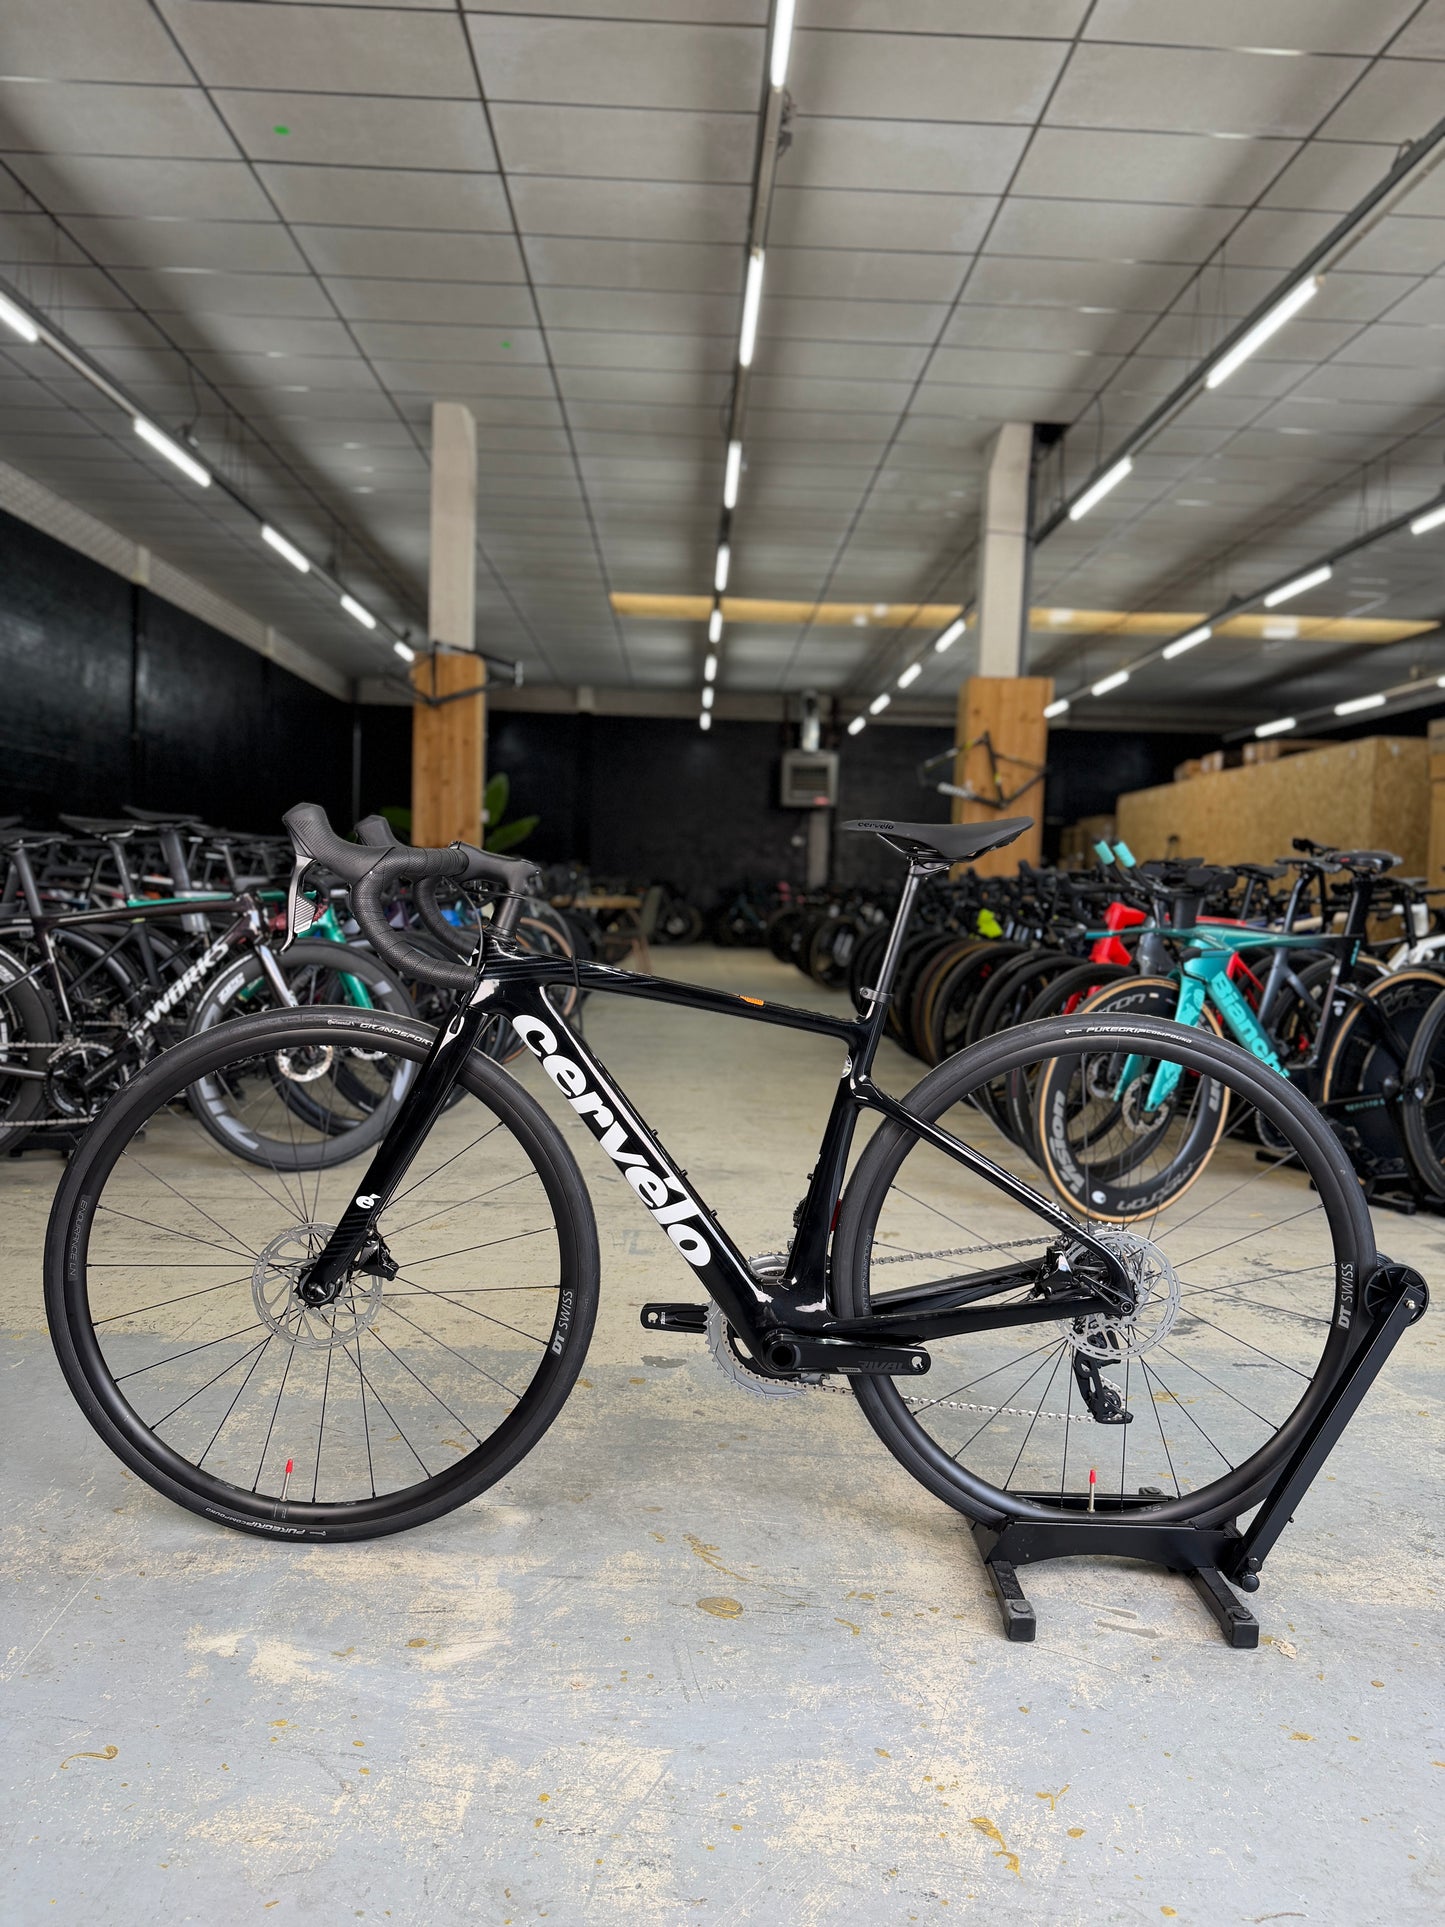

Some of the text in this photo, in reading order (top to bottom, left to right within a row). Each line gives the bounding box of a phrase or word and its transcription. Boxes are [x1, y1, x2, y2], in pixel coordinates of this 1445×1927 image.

[512, 1014, 711, 1267] cervélo
[70, 1200, 88, 1261] ENDURANCE
[551, 1289, 573, 1355] DT SWISS
[1338, 1263, 1354, 1329] DT SWISS
